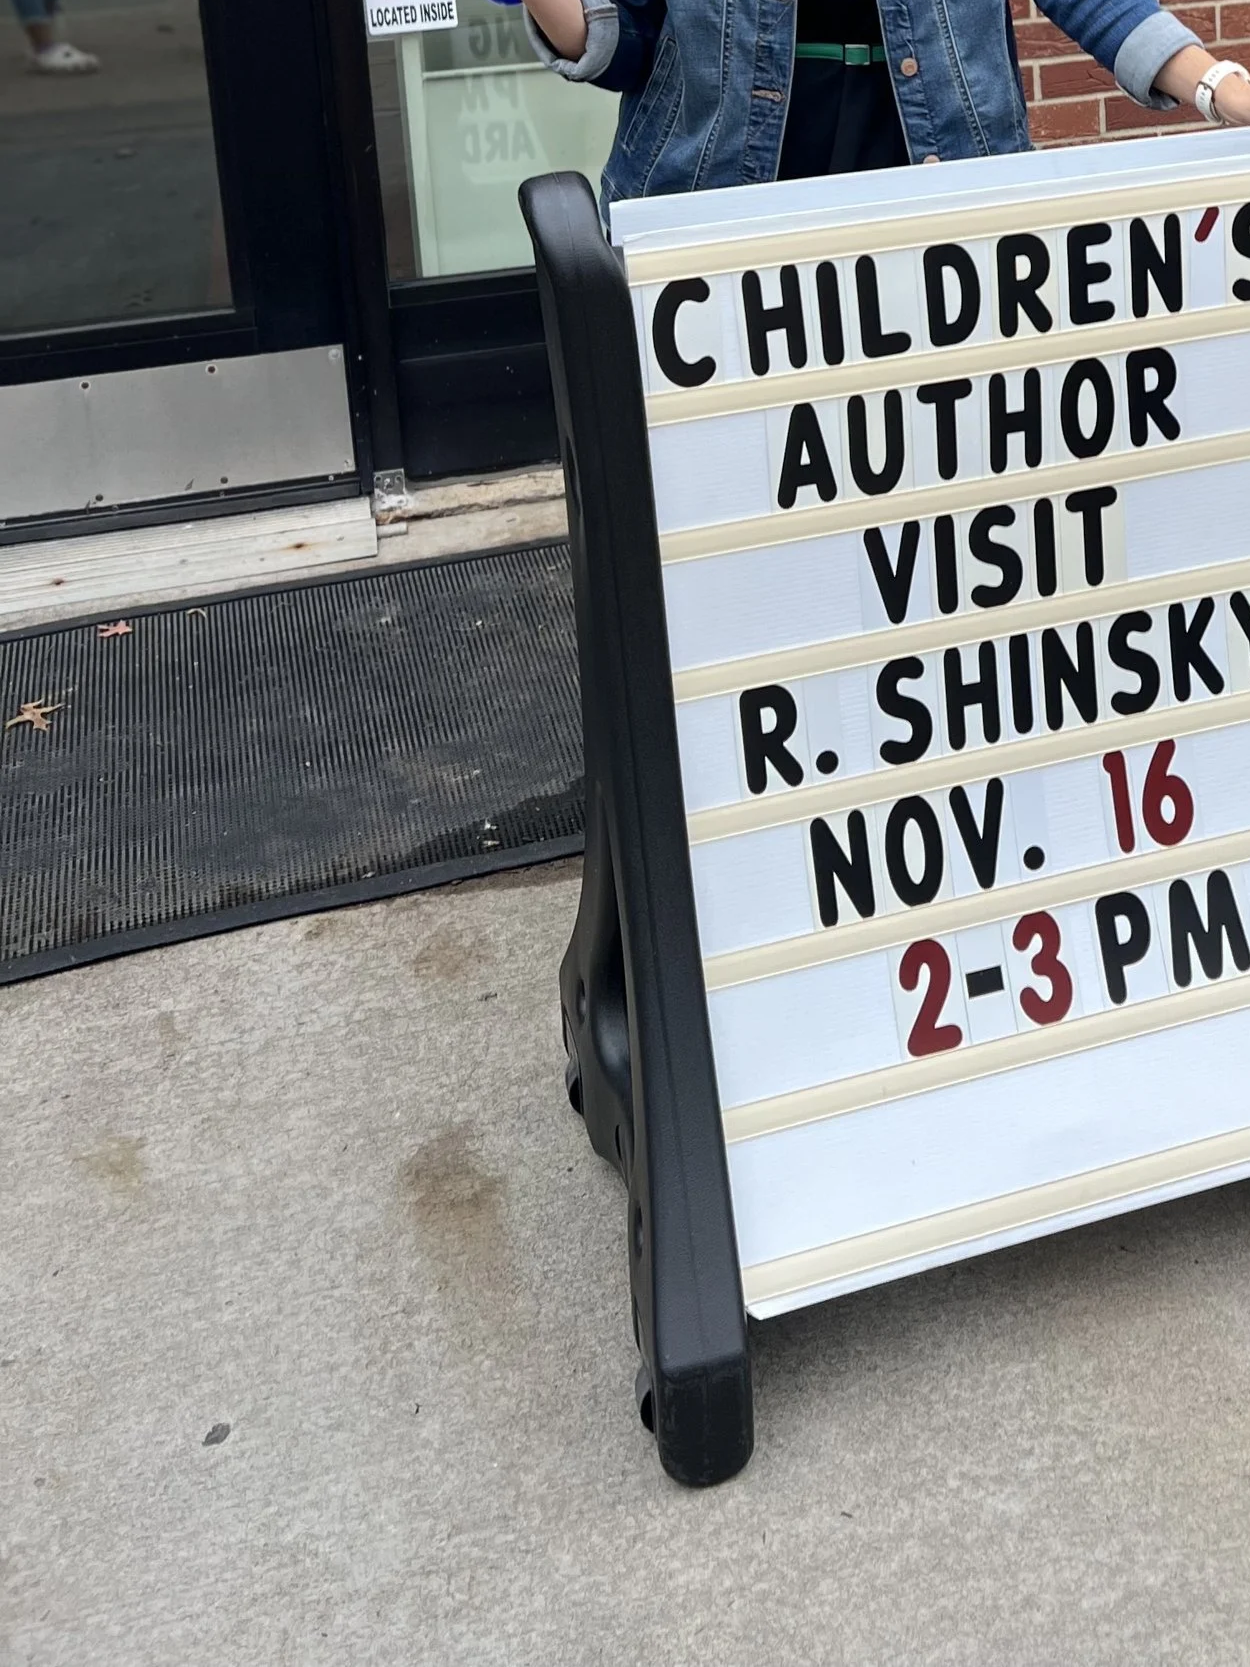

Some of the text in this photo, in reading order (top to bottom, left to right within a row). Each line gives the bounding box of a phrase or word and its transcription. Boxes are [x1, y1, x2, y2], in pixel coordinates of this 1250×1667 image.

[370, 1, 454, 27] LOCATED INSIDE
[778, 347, 1180, 509] AUTHOR
[864, 486, 1117, 624] VISIT
[740, 685, 838, 794] R.
[810, 739, 1193, 927] NOV. 16
